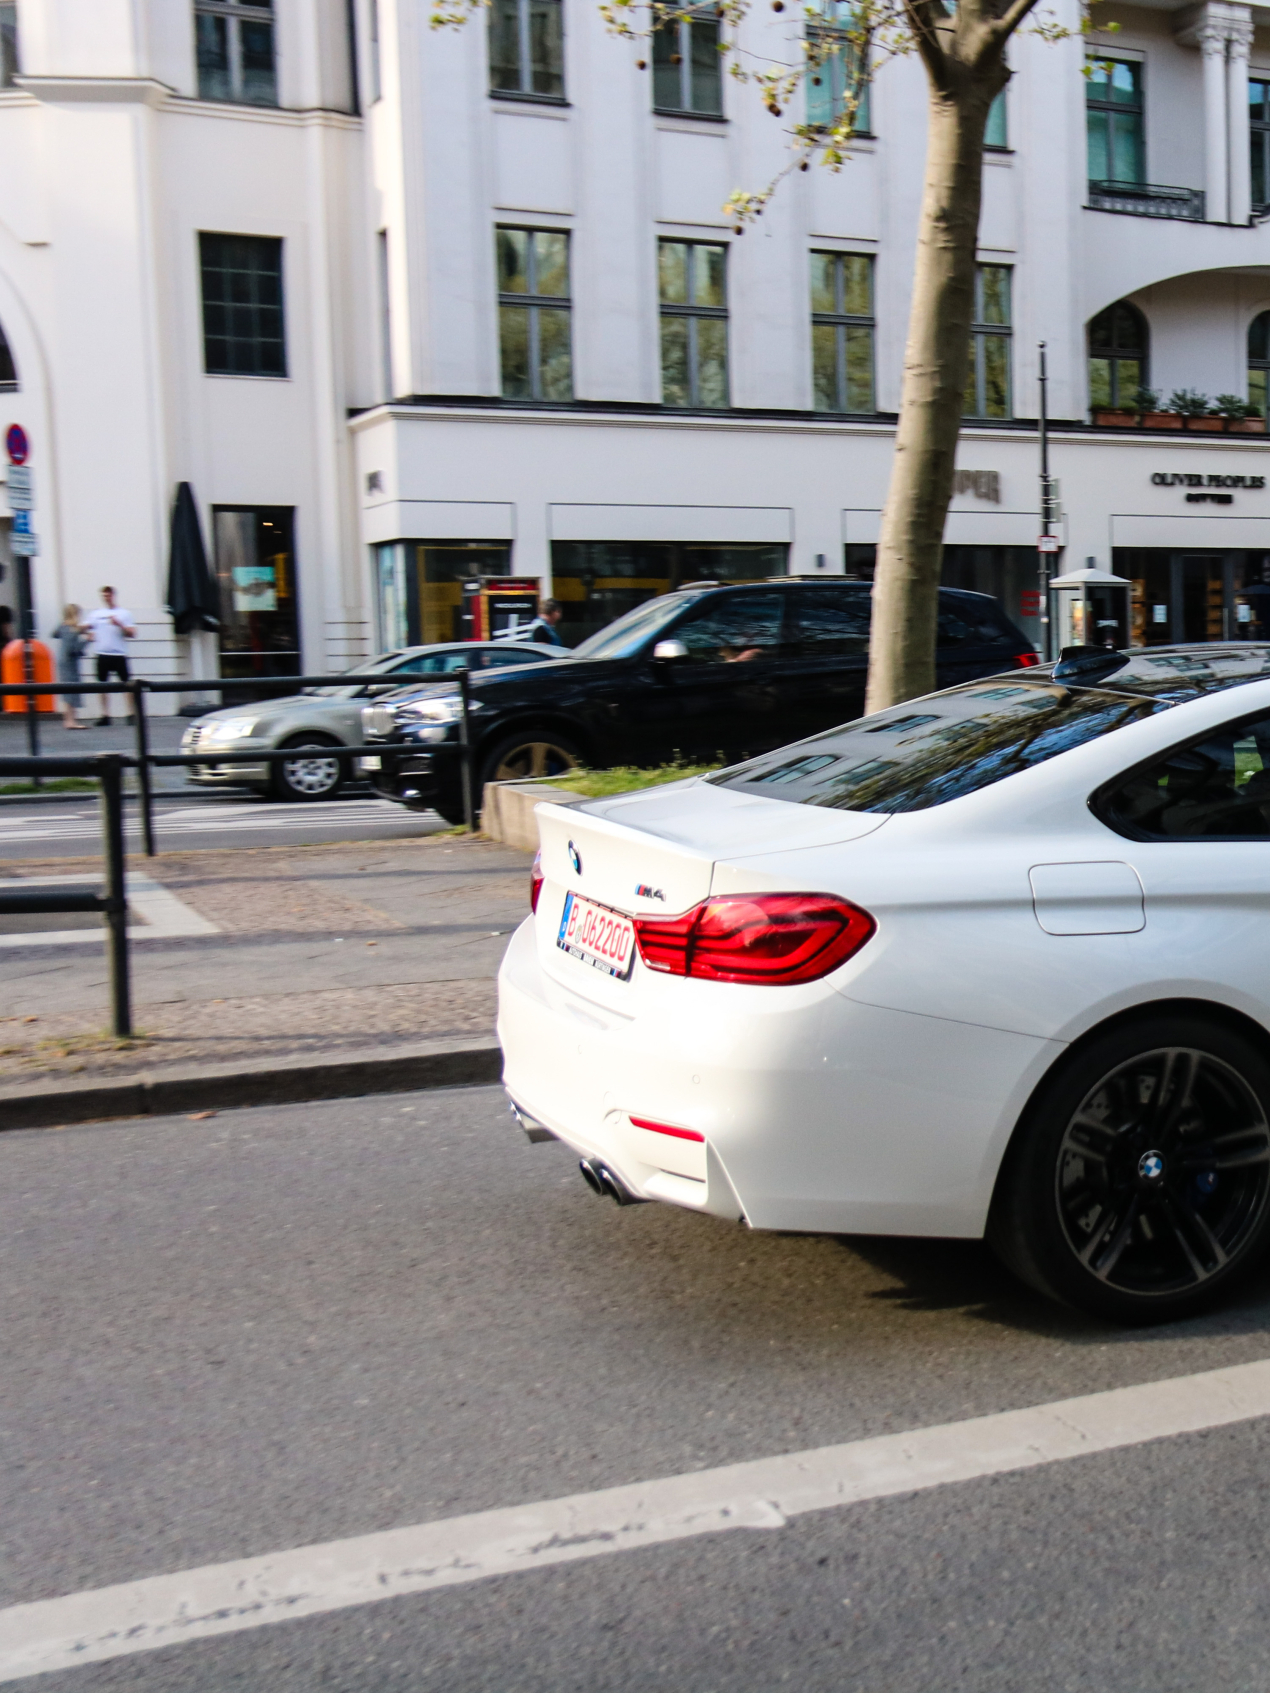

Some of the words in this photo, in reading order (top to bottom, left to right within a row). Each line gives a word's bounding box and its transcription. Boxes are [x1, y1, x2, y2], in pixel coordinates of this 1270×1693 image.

[1151, 472, 1203, 487] OLIVER
[1206, 474, 1266, 489] PEOPLES
[642, 884, 666, 902] M4
